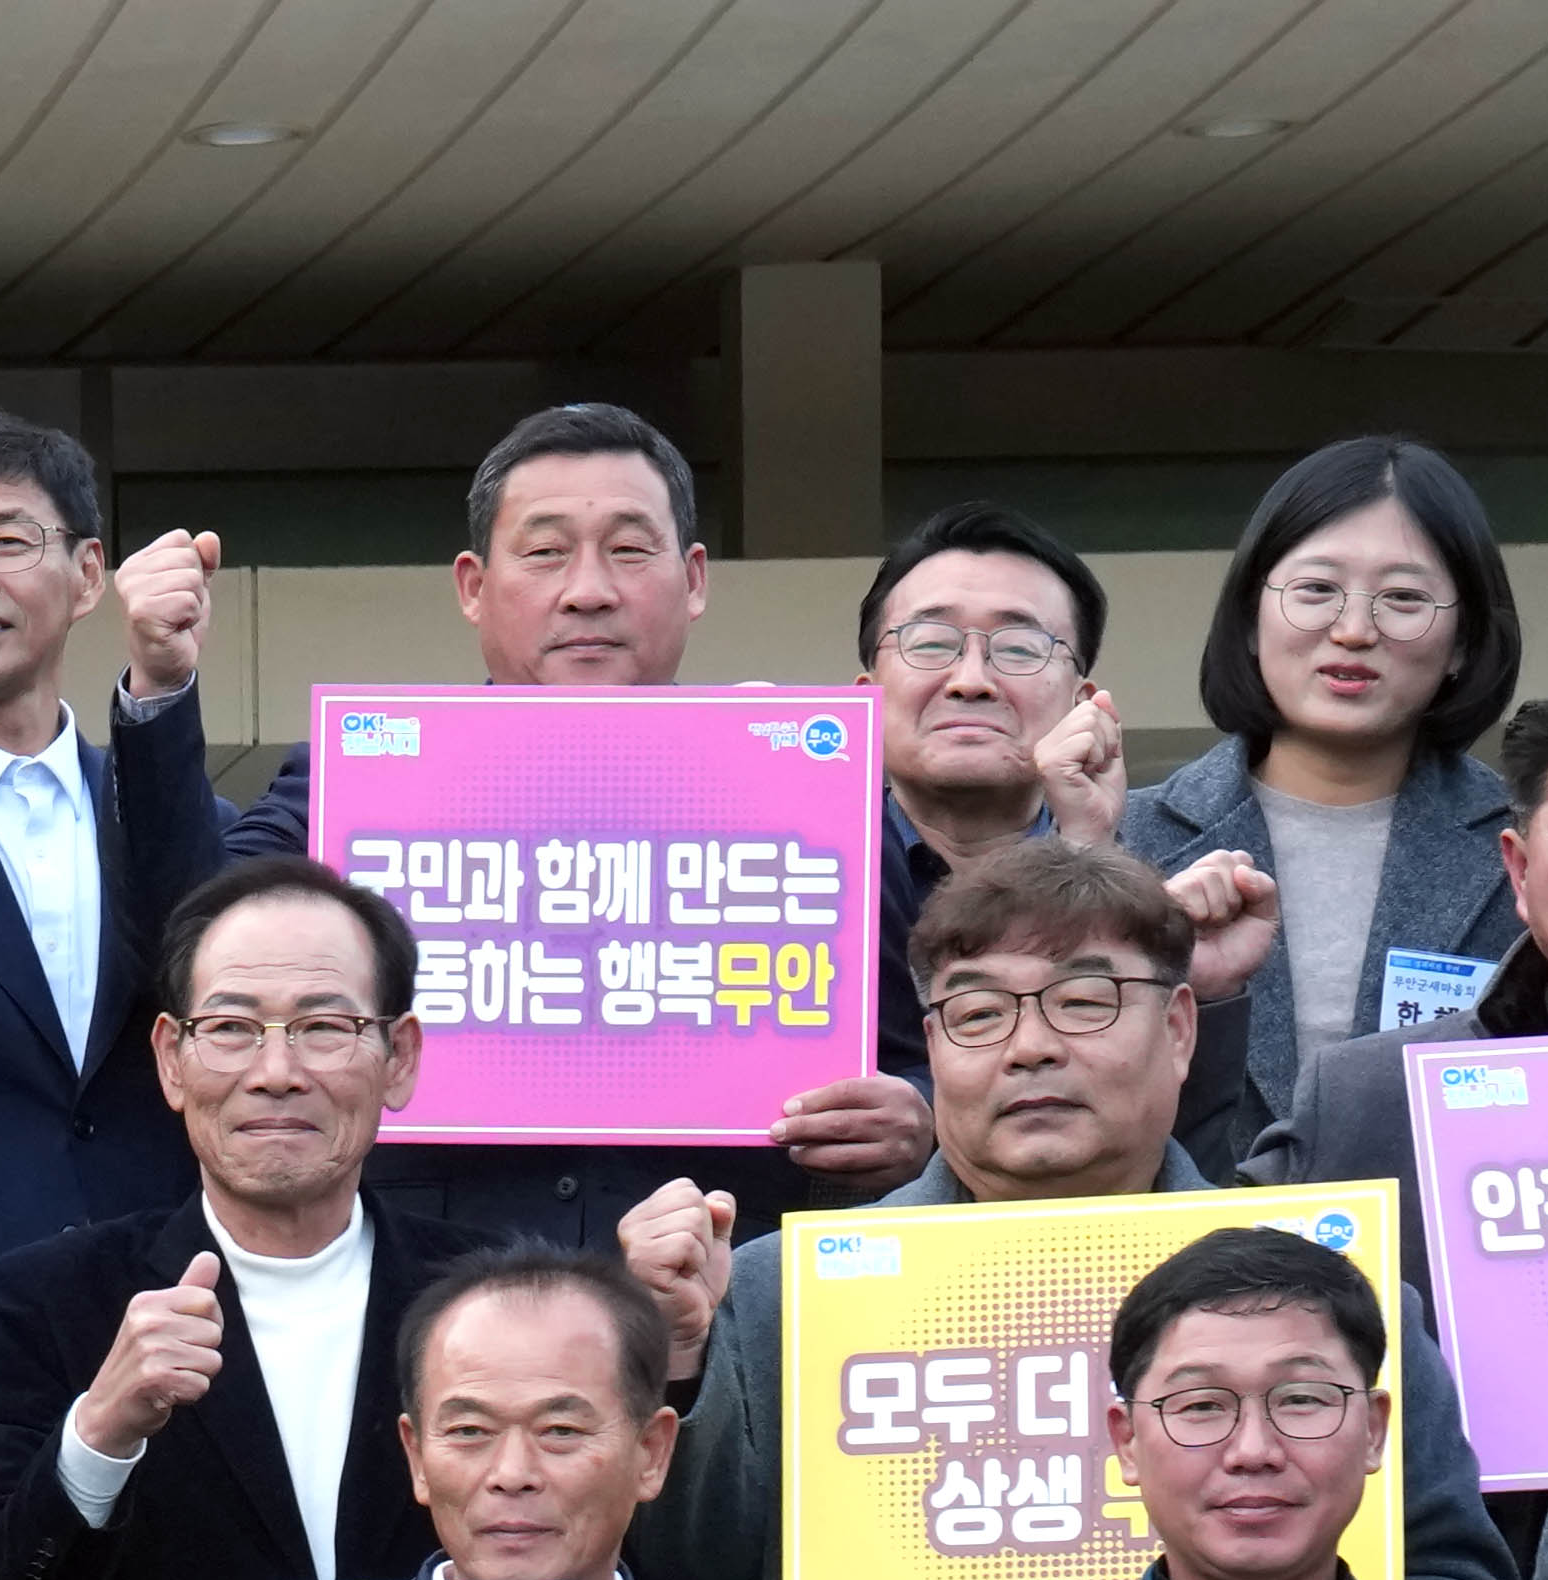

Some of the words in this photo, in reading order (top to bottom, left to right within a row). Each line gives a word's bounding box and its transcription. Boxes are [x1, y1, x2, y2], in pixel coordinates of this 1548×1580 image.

[535, 838, 651, 925] 함께
[667, 841, 841, 925] 만드는
[1471, 1167, 1548, 1252] 안
[845, 1356, 996, 1445] 모두
[1016, 1351, 1089, 1438] 더
[931, 1454, 1083, 1546] 상생
